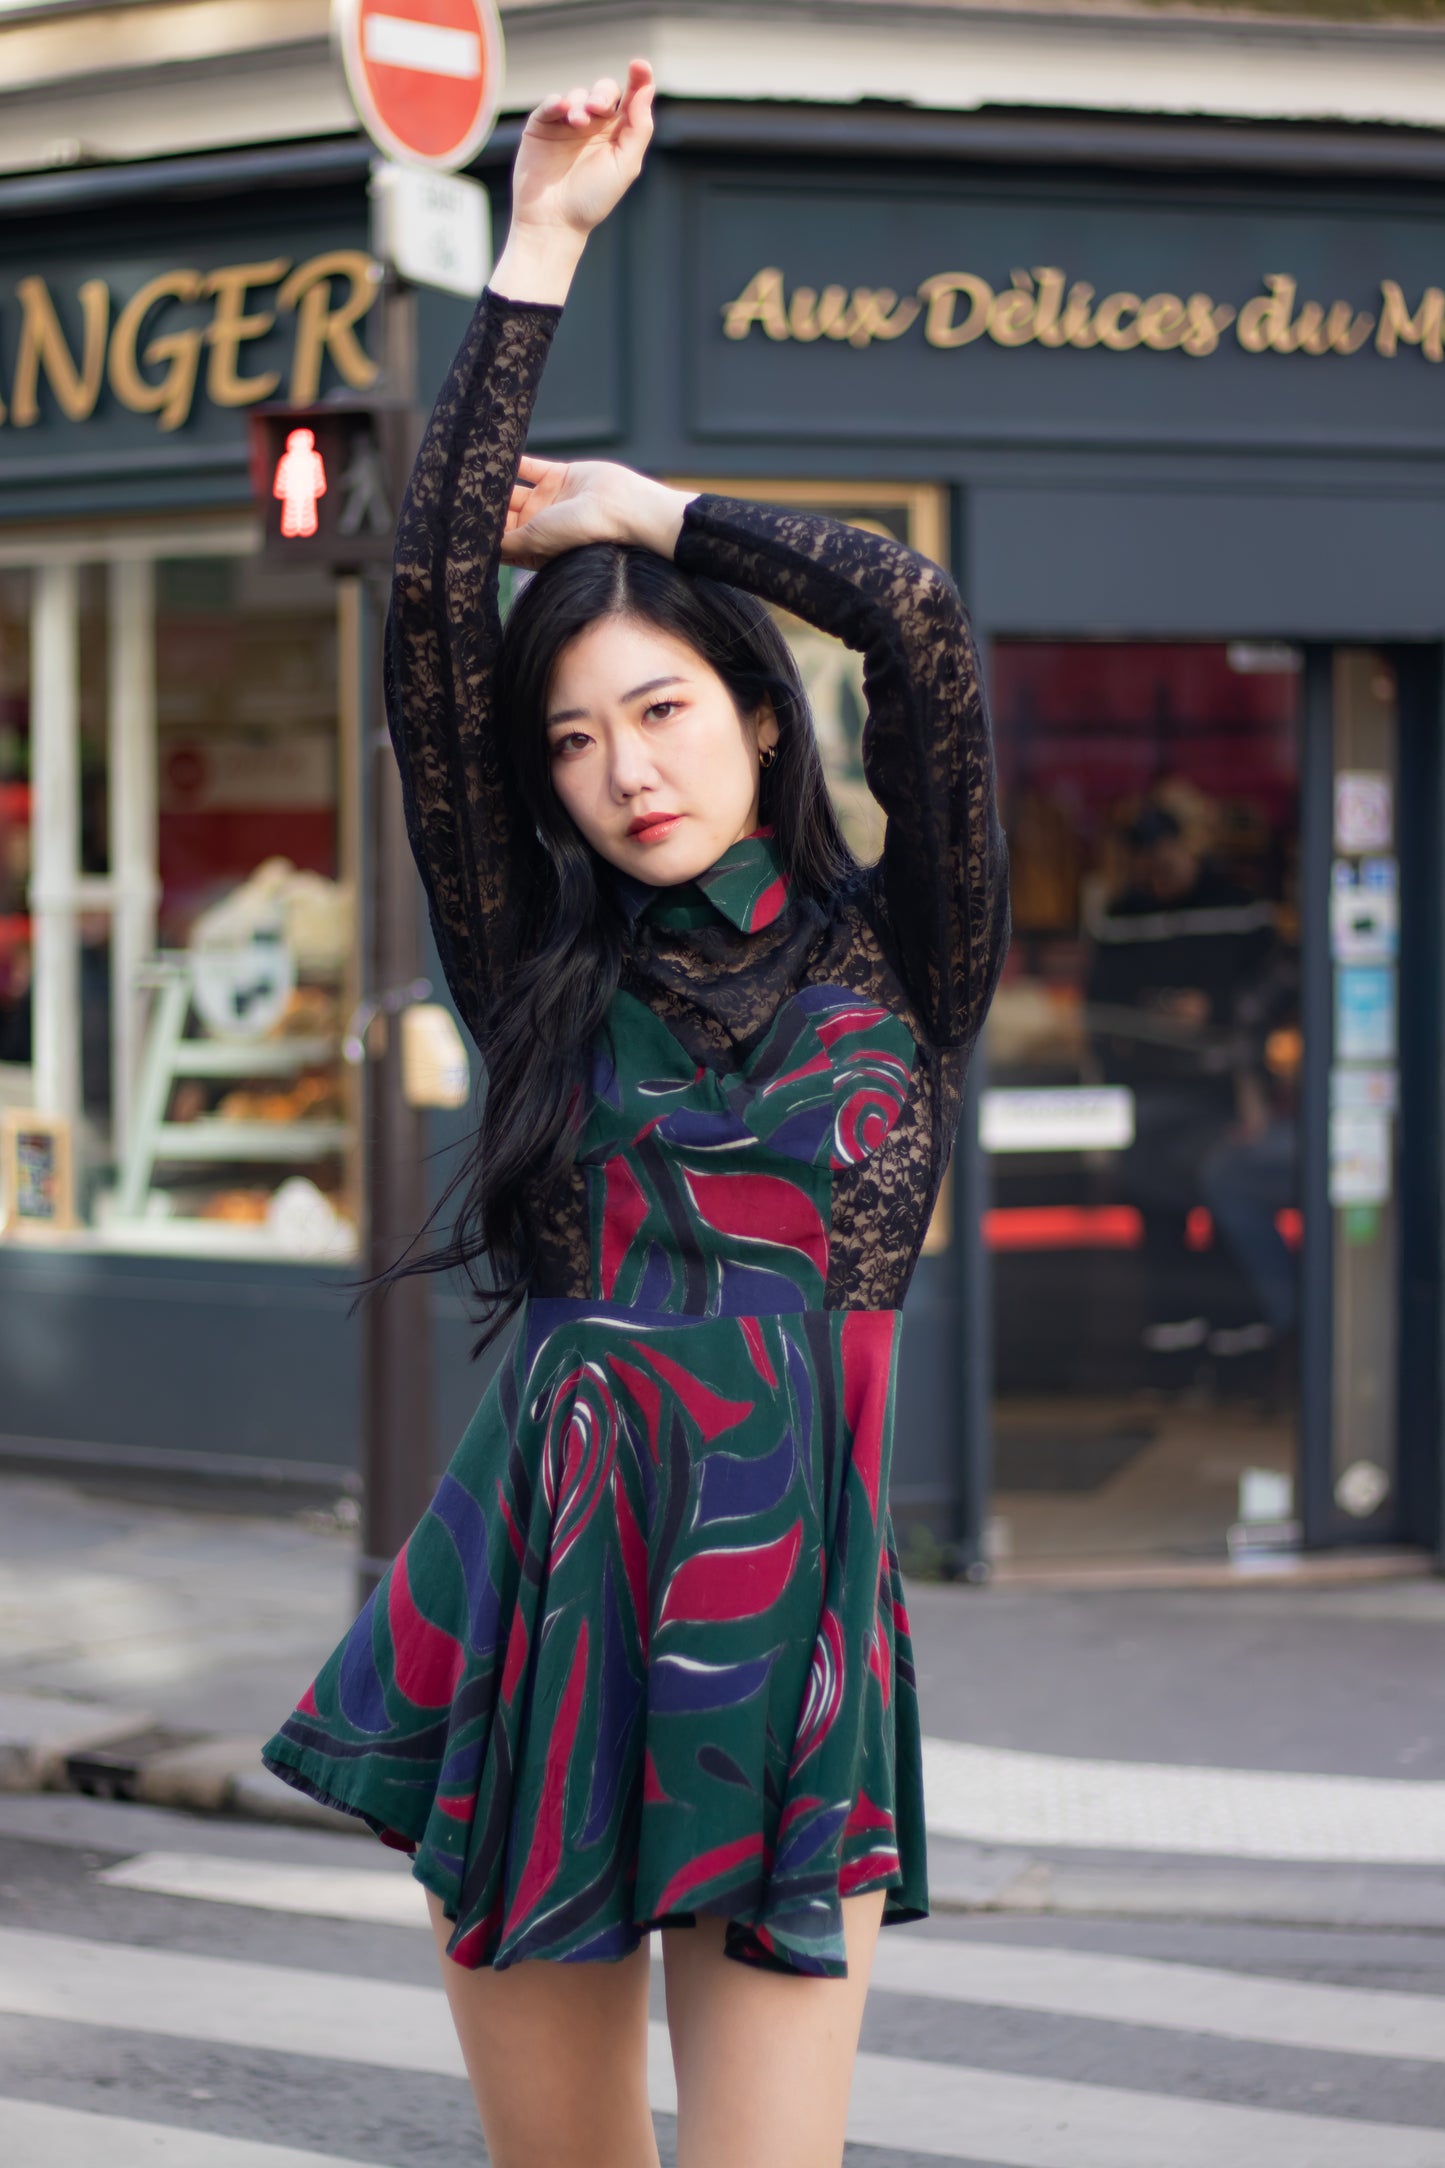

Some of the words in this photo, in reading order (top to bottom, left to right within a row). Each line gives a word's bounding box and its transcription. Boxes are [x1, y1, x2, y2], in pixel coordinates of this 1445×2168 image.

[0, 249, 380, 432] NGER
[720, 266, 921, 349] Aux
[1236, 273, 1375, 355] du
[1375, 279, 1445, 363] M
